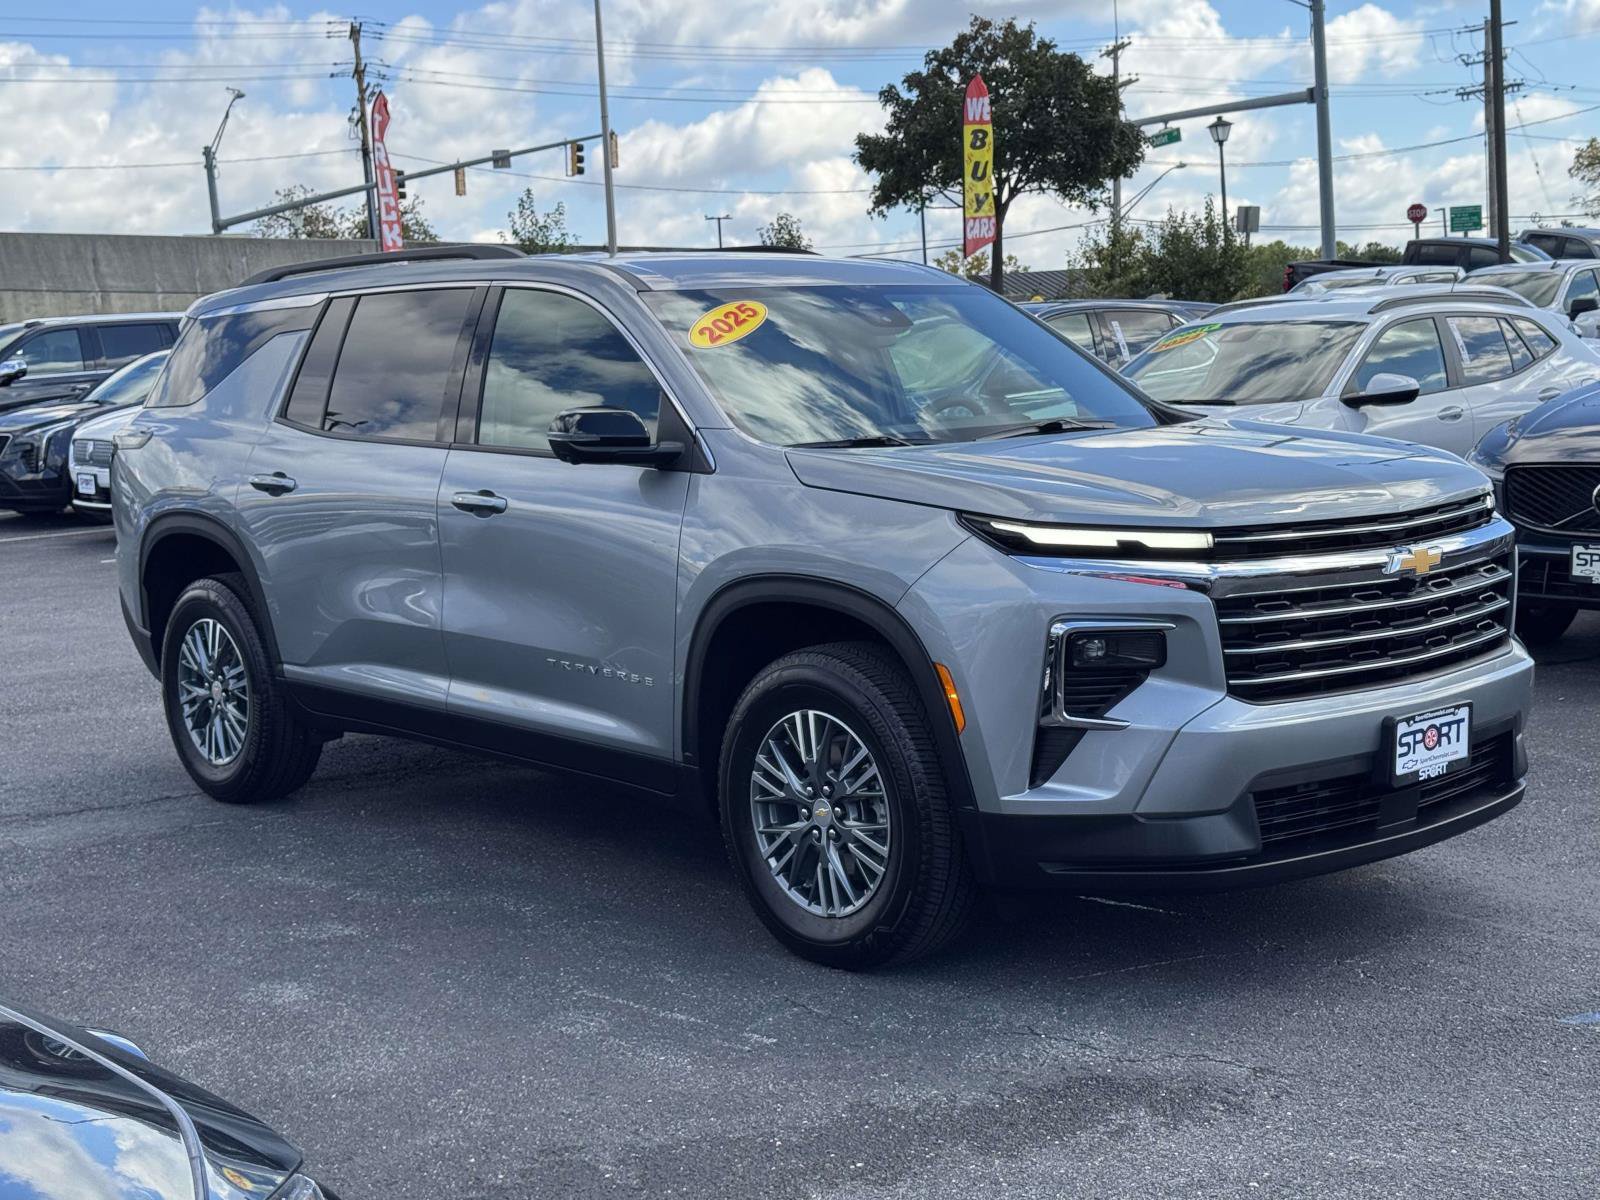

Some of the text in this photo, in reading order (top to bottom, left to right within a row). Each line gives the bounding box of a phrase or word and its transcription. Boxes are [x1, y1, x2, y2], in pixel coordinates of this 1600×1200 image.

[966, 97, 992, 121] WE
[969, 128, 990, 214] BUY
[1408, 208, 1427, 218] STOP
[965, 217, 996, 240] CARS
[698, 303, 758, 344] 2025
[546, 658, 654, 687] TRAVERSE
[1398, 718, 1465, 759] SPORT
[1418, 761, 1448, 781] SPORT
